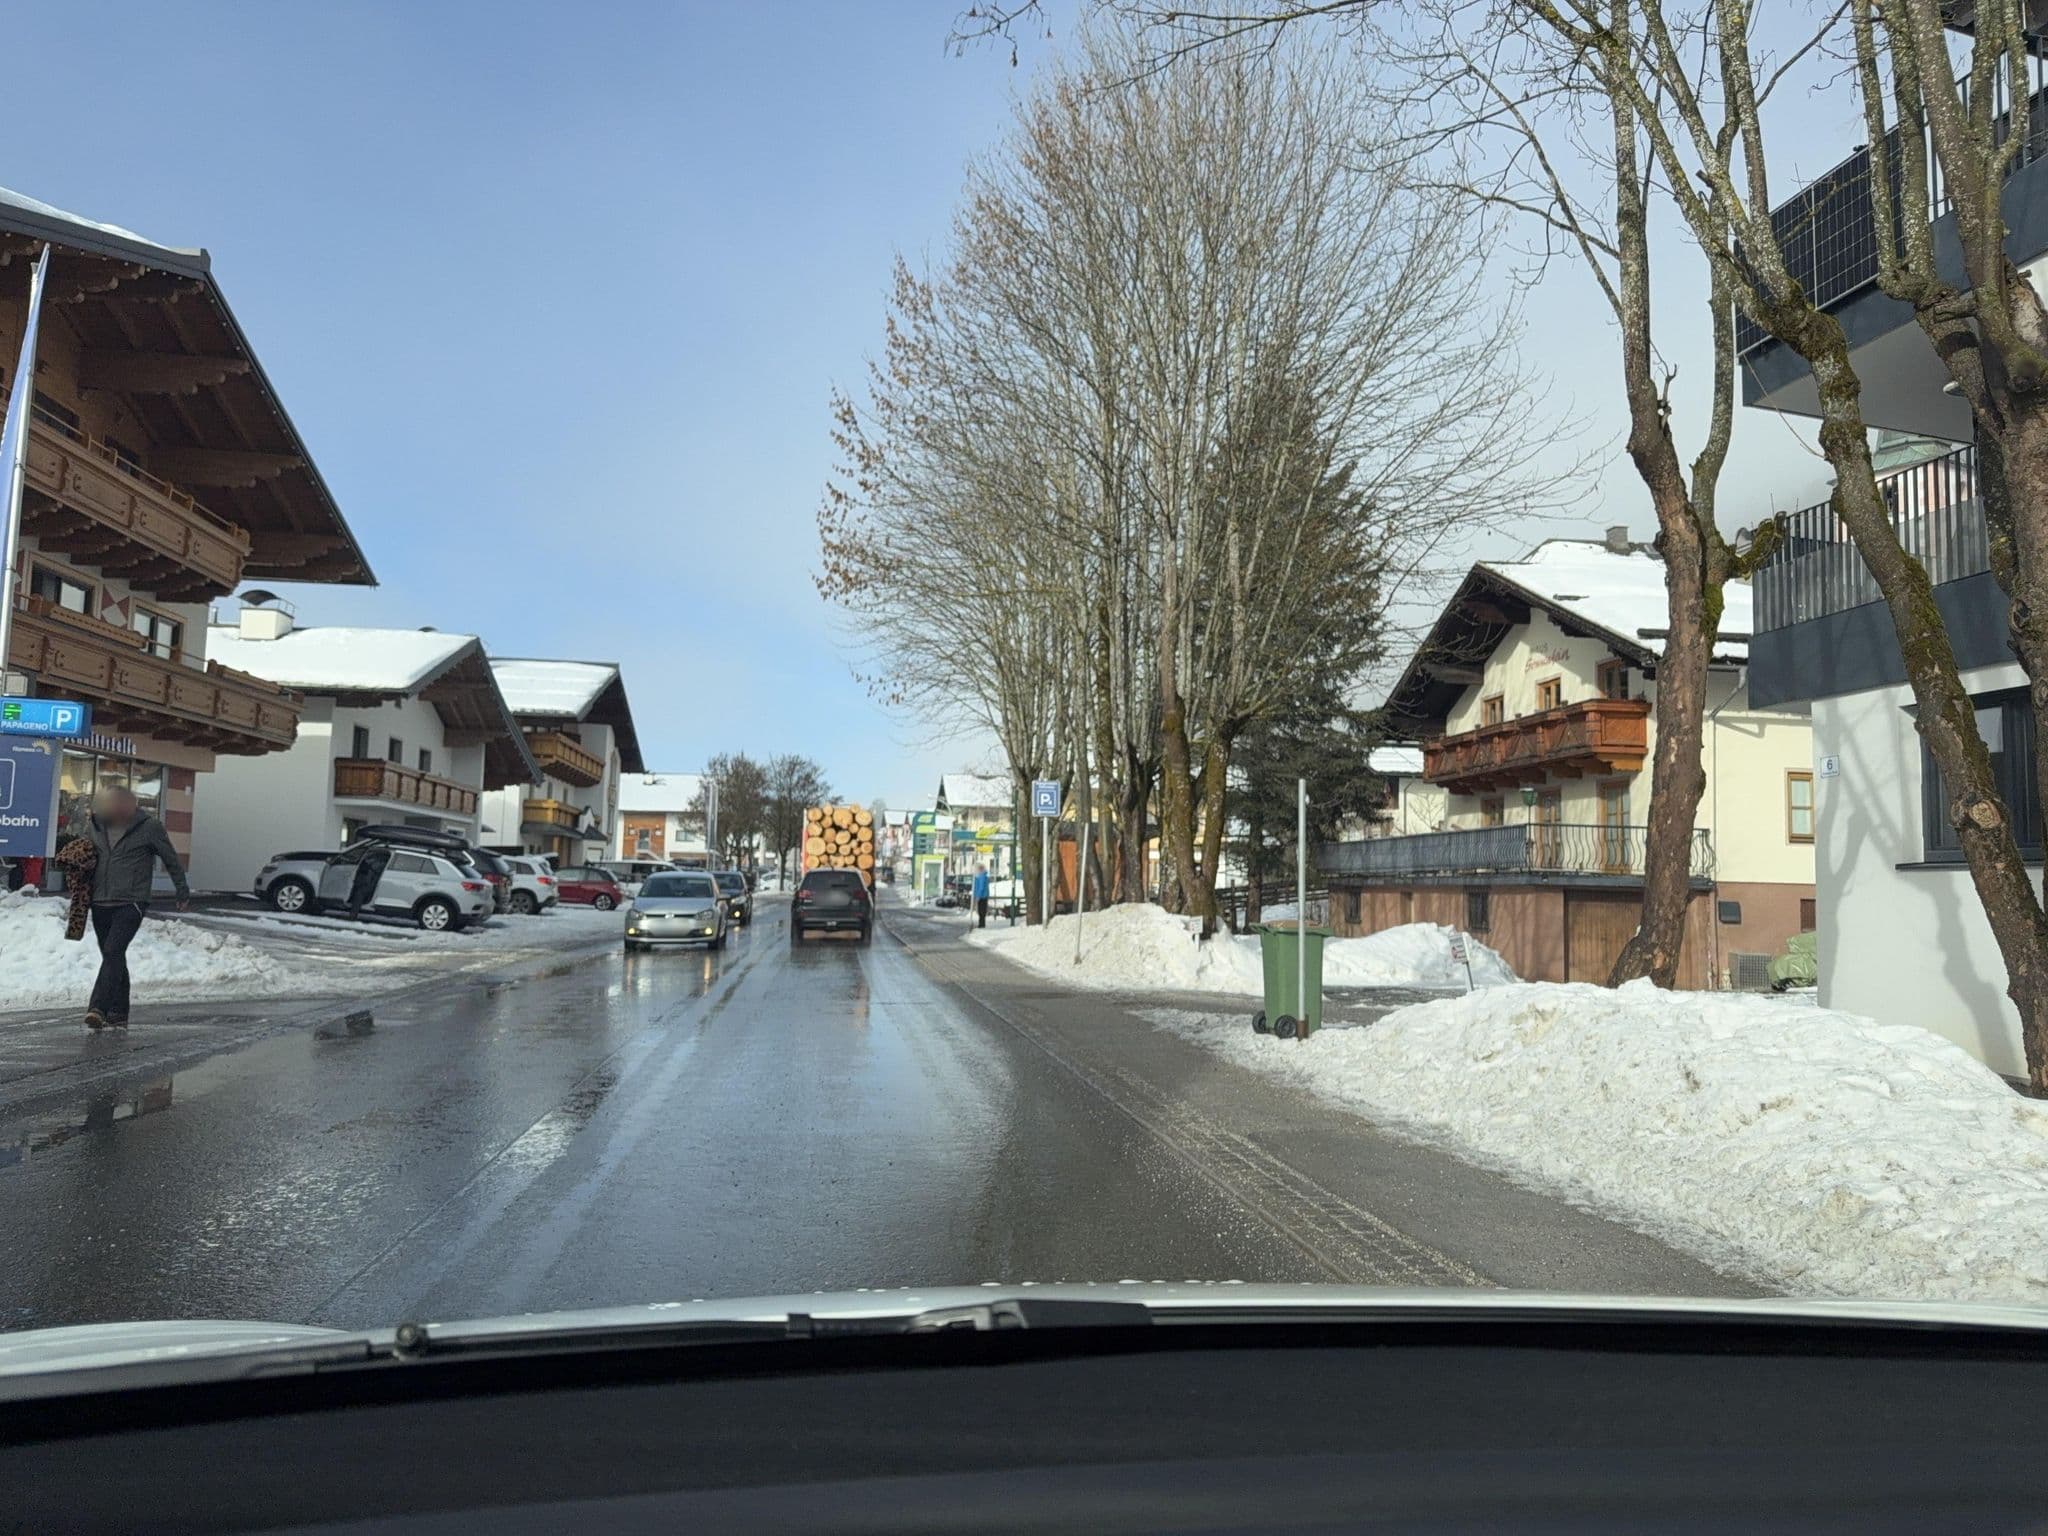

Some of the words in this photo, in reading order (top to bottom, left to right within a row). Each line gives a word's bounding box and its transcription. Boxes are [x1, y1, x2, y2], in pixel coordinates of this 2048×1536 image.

[0, 720, 49, 731] PAPAGENO
[57, 709, 72, 729] P
[1827, 759, 1833, 770] 6
[1040, 793, 1051, 806] P
[0, 814, 40, 827] bahn
